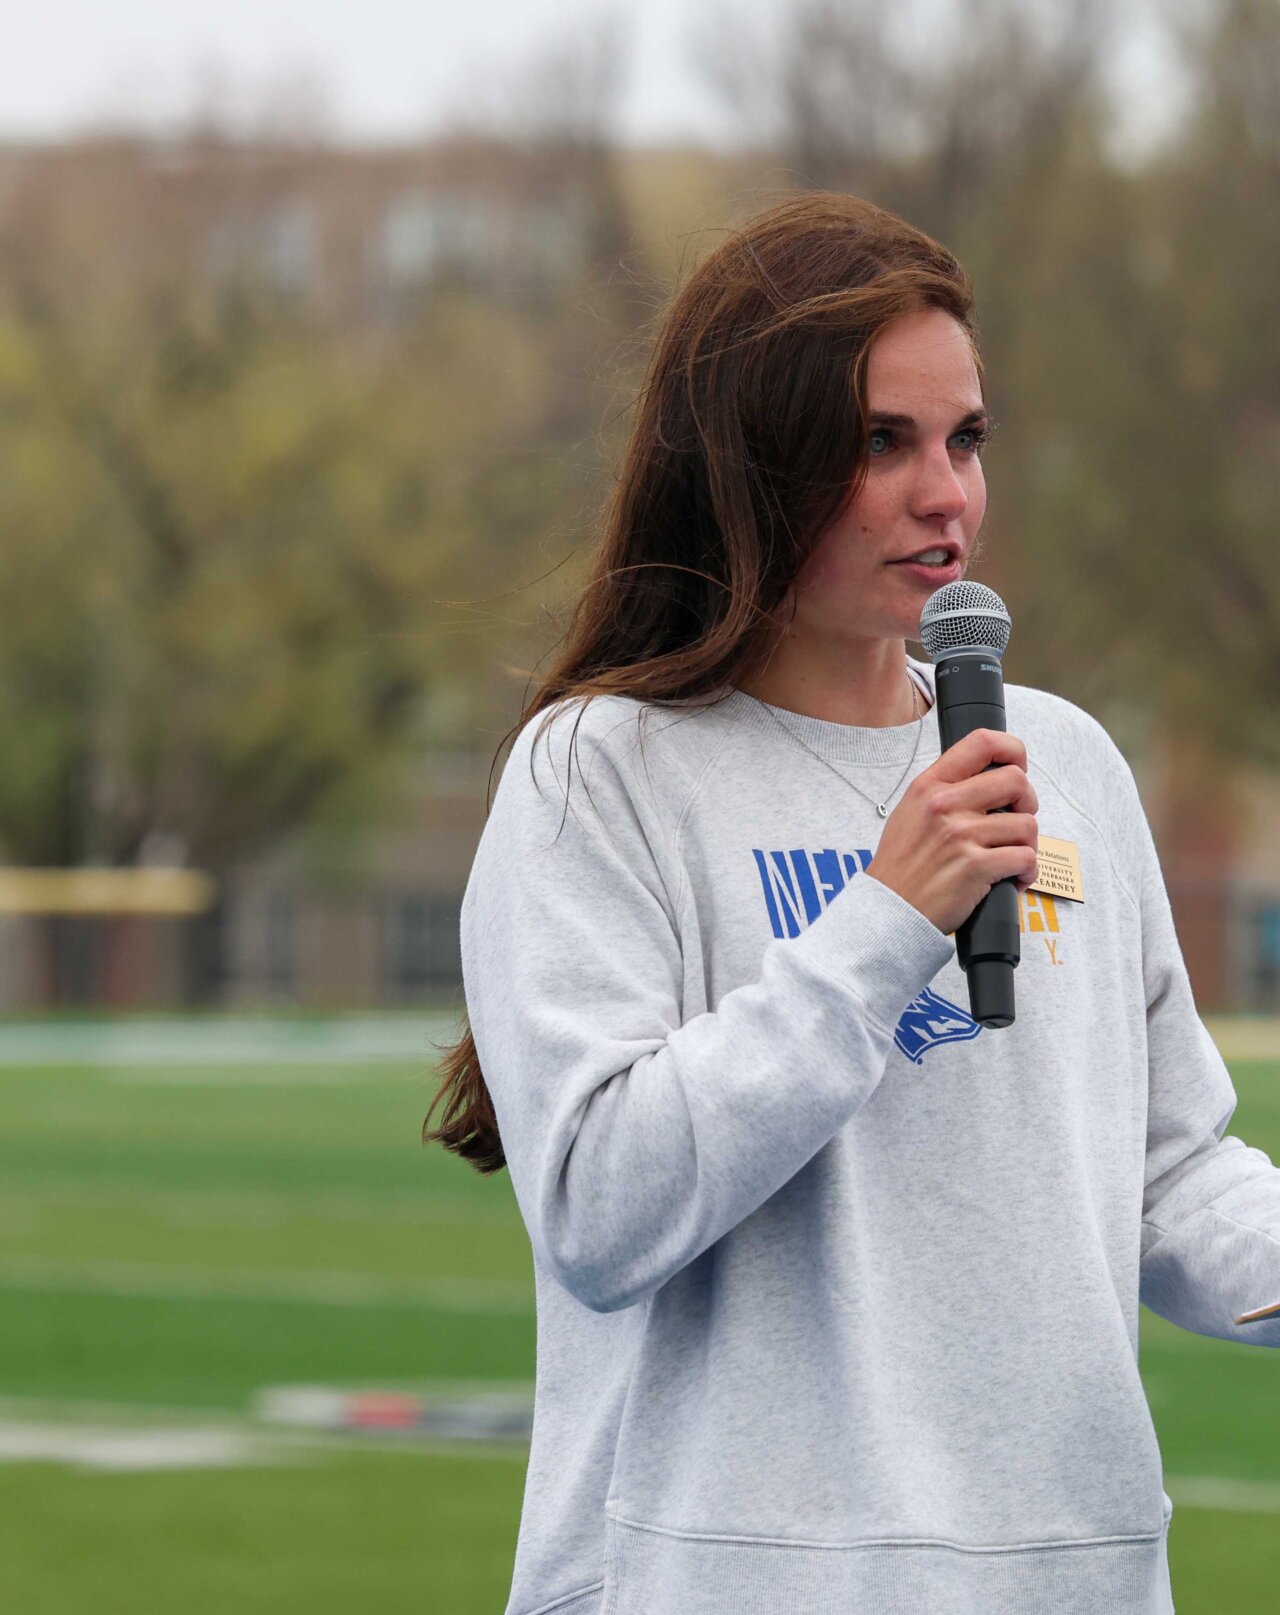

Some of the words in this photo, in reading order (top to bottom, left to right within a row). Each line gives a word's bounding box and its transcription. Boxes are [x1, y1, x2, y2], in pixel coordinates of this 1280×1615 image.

[1045, 850, 1069, 862] Relations
[1038, 864, 1073, 876] IVERSITY
[1041, 871, 1074, 883] NEBRASKA
